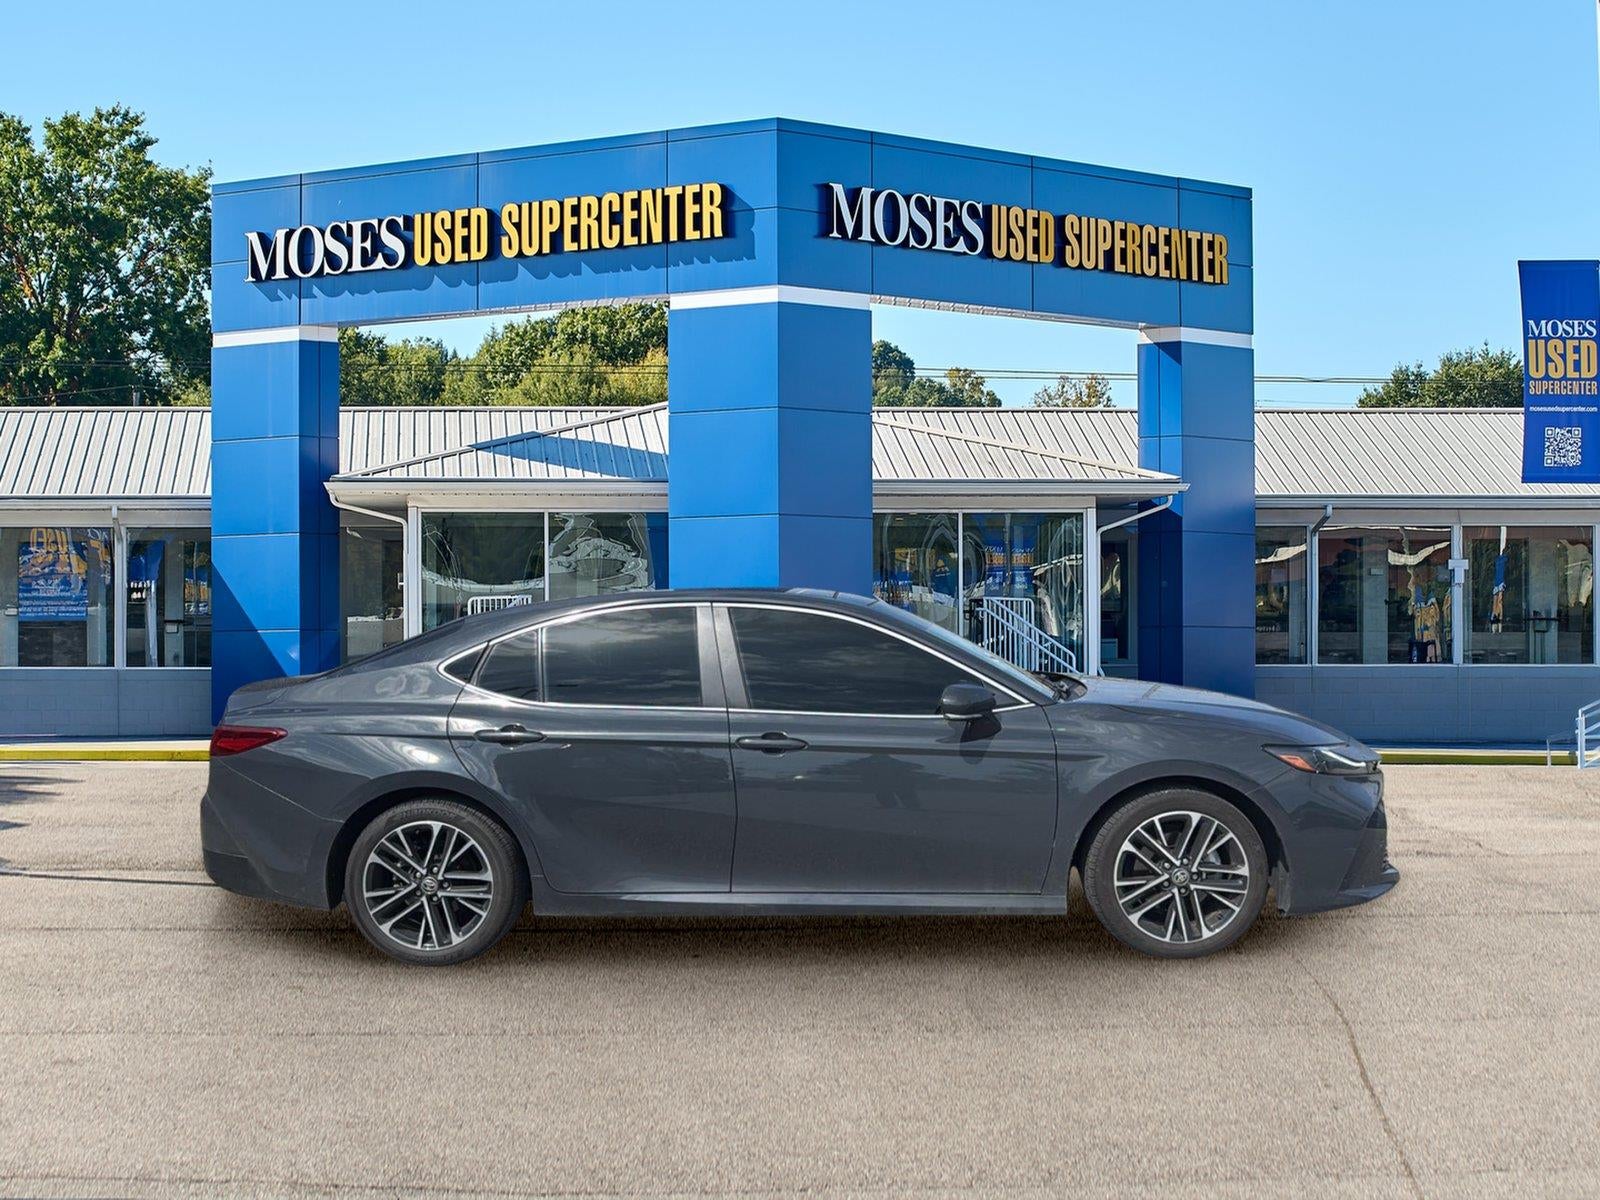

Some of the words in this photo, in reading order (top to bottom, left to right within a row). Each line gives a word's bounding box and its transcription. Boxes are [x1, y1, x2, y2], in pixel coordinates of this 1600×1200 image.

[244, 216, 407, 283] MOSES
[413, 207, 489, 266] USED
[500, 182, 723, 259] SUPERCENTER
[828, 182, 984, 255] MOSES
[991, 204, 1055, 264] USED
[1065, 213, 1229, 284] SUPERCENTER
[1527, 319, 1597, 338] MOSES
[1528, 338, 1598, 379] USED
[1529, 380, 1598, 395] SUPERCENTER
